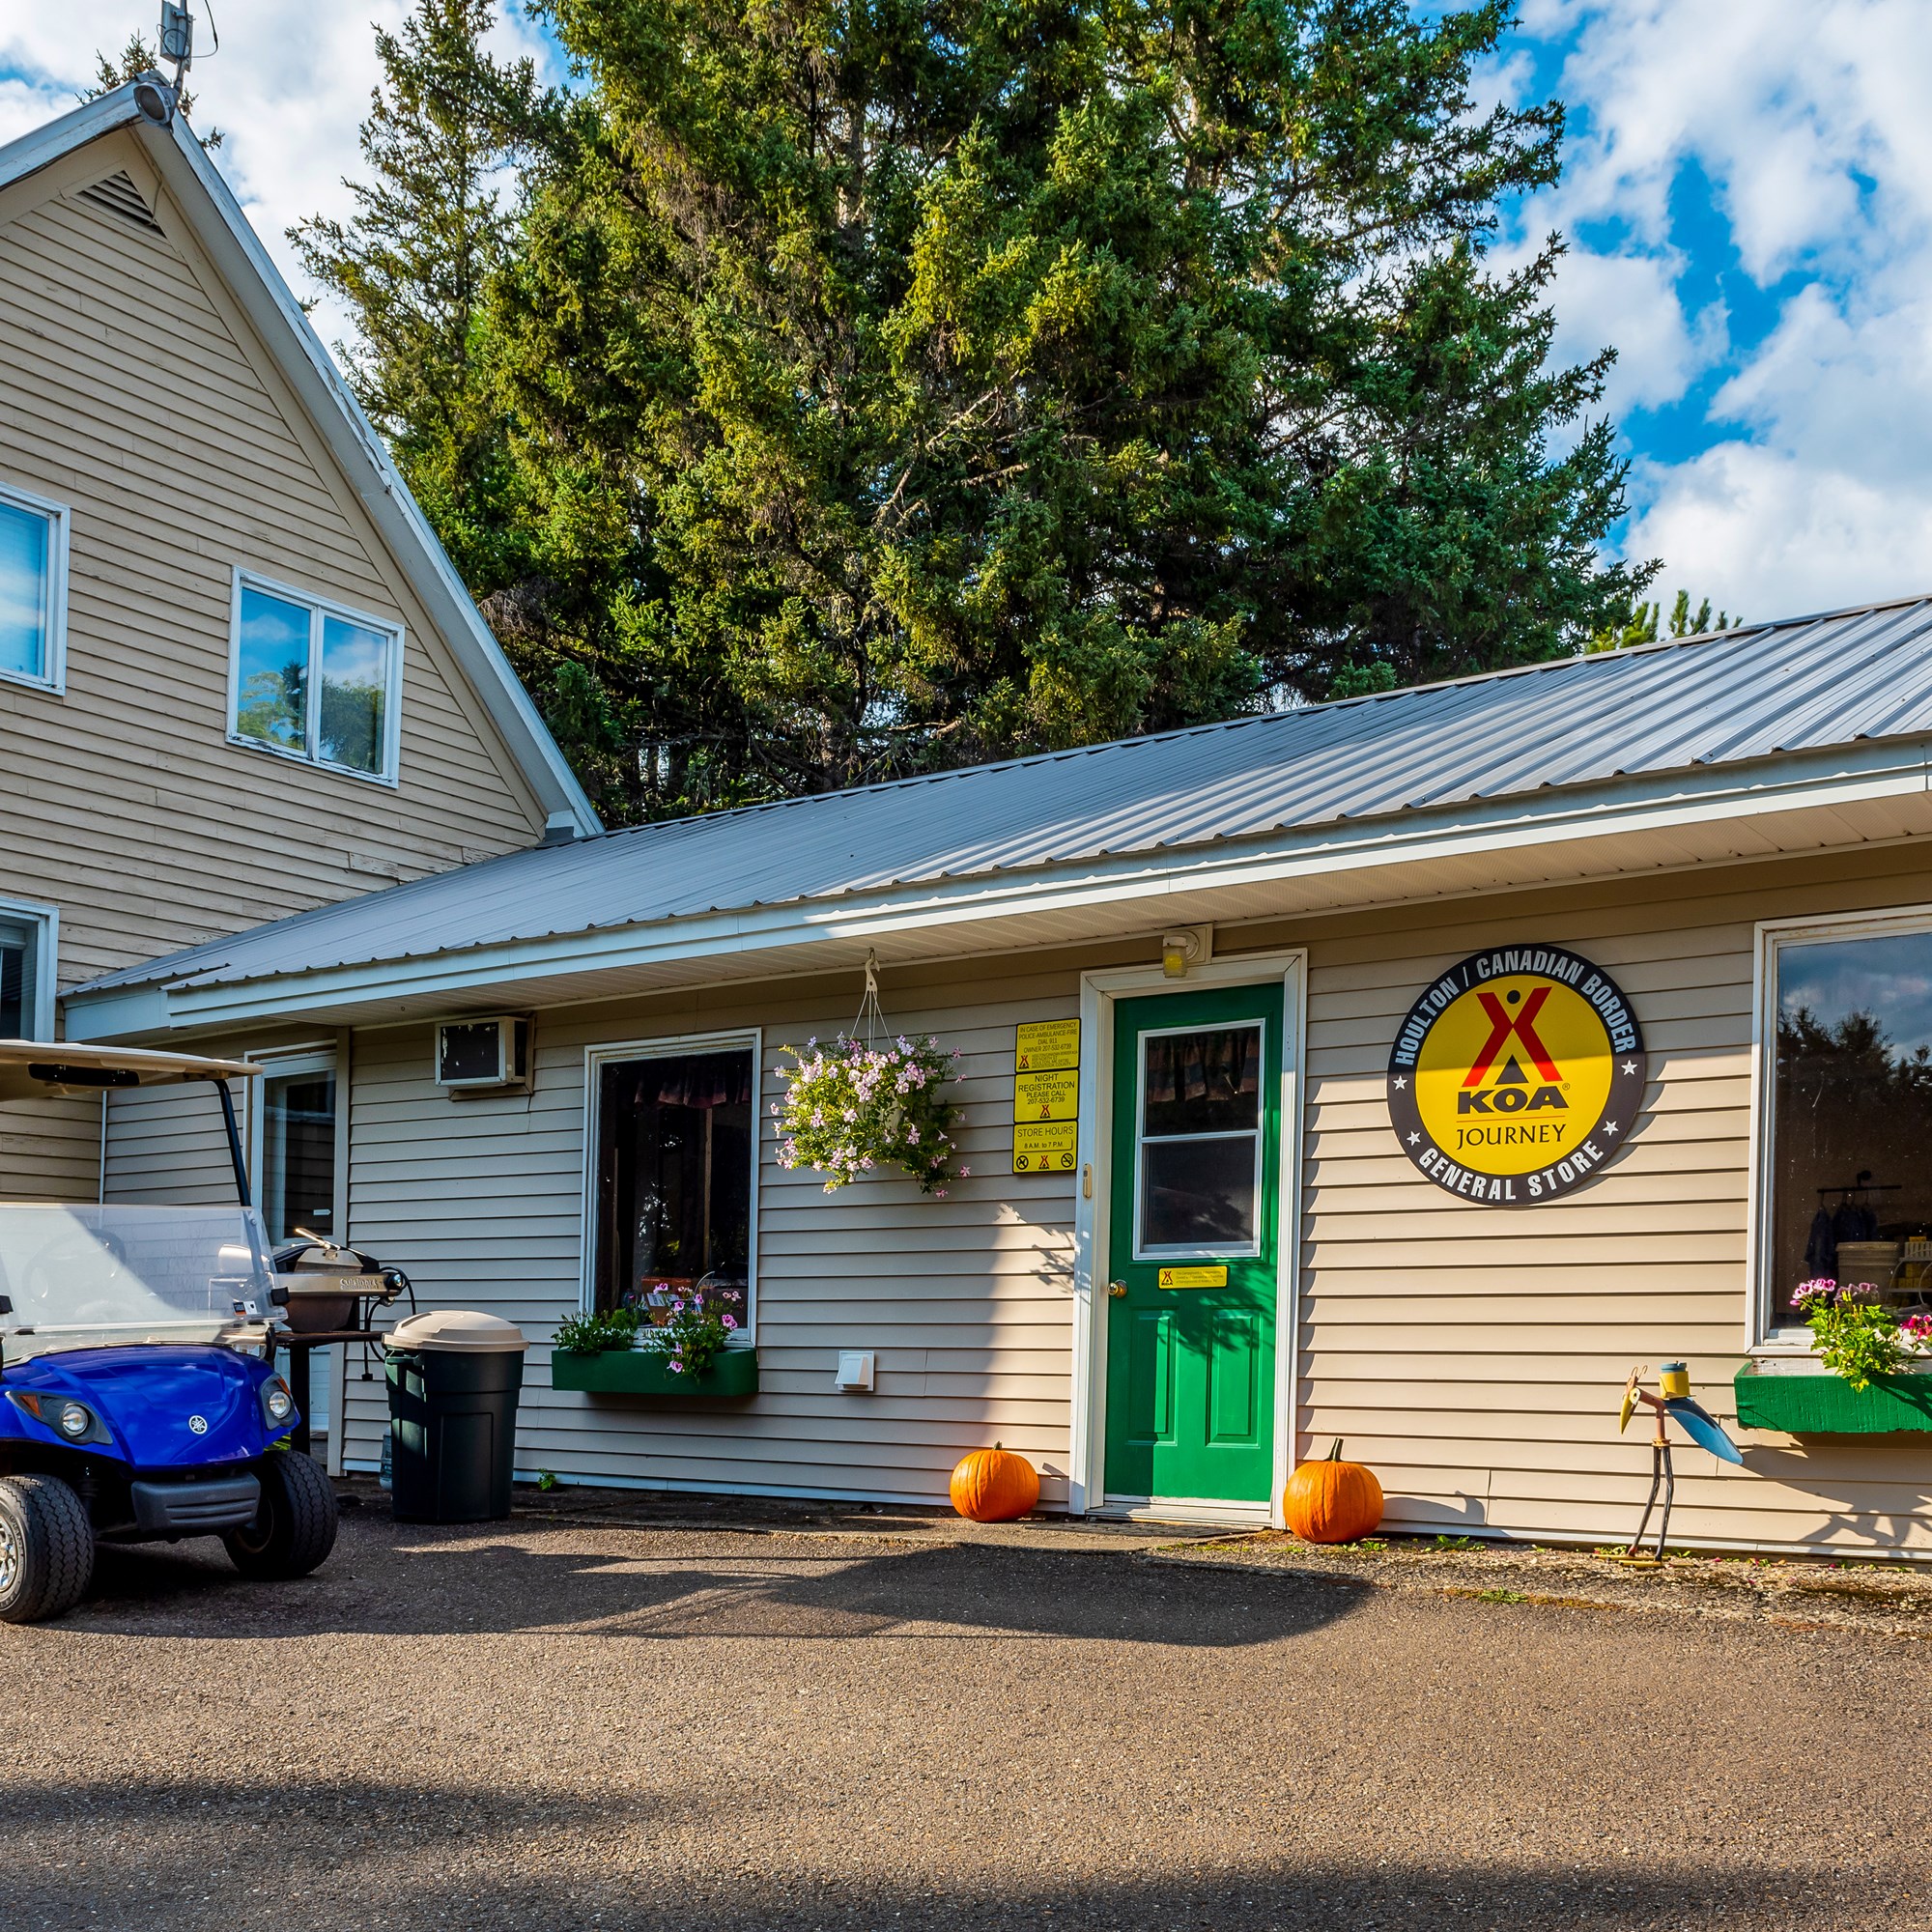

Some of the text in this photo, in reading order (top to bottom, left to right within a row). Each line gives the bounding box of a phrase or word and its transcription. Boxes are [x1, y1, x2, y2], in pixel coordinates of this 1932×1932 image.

[1395, 977, 1460, 1065] HOULTON
[1476, 950, 1585, 984] CANADIAN
[1580, 973, 1636, 1053] BORDER
[1047, 1022, 1077, 1030] EMERGENCY
[1035, 1073, 1059, 1082] NIGHT
[1018, 1081, 1075, 1092] REGISTRATION
[1027, 1096, 1065, 1104] 207-532-6739
[1458, 1085, 1570, 1114] KOA
[1018, 1126, 1073, 1137] STORE HOURS
[1457, 1123, 1566, 1150] JOURNEY
[1419, 1140, 1604, 1200] GENERAL STORE
